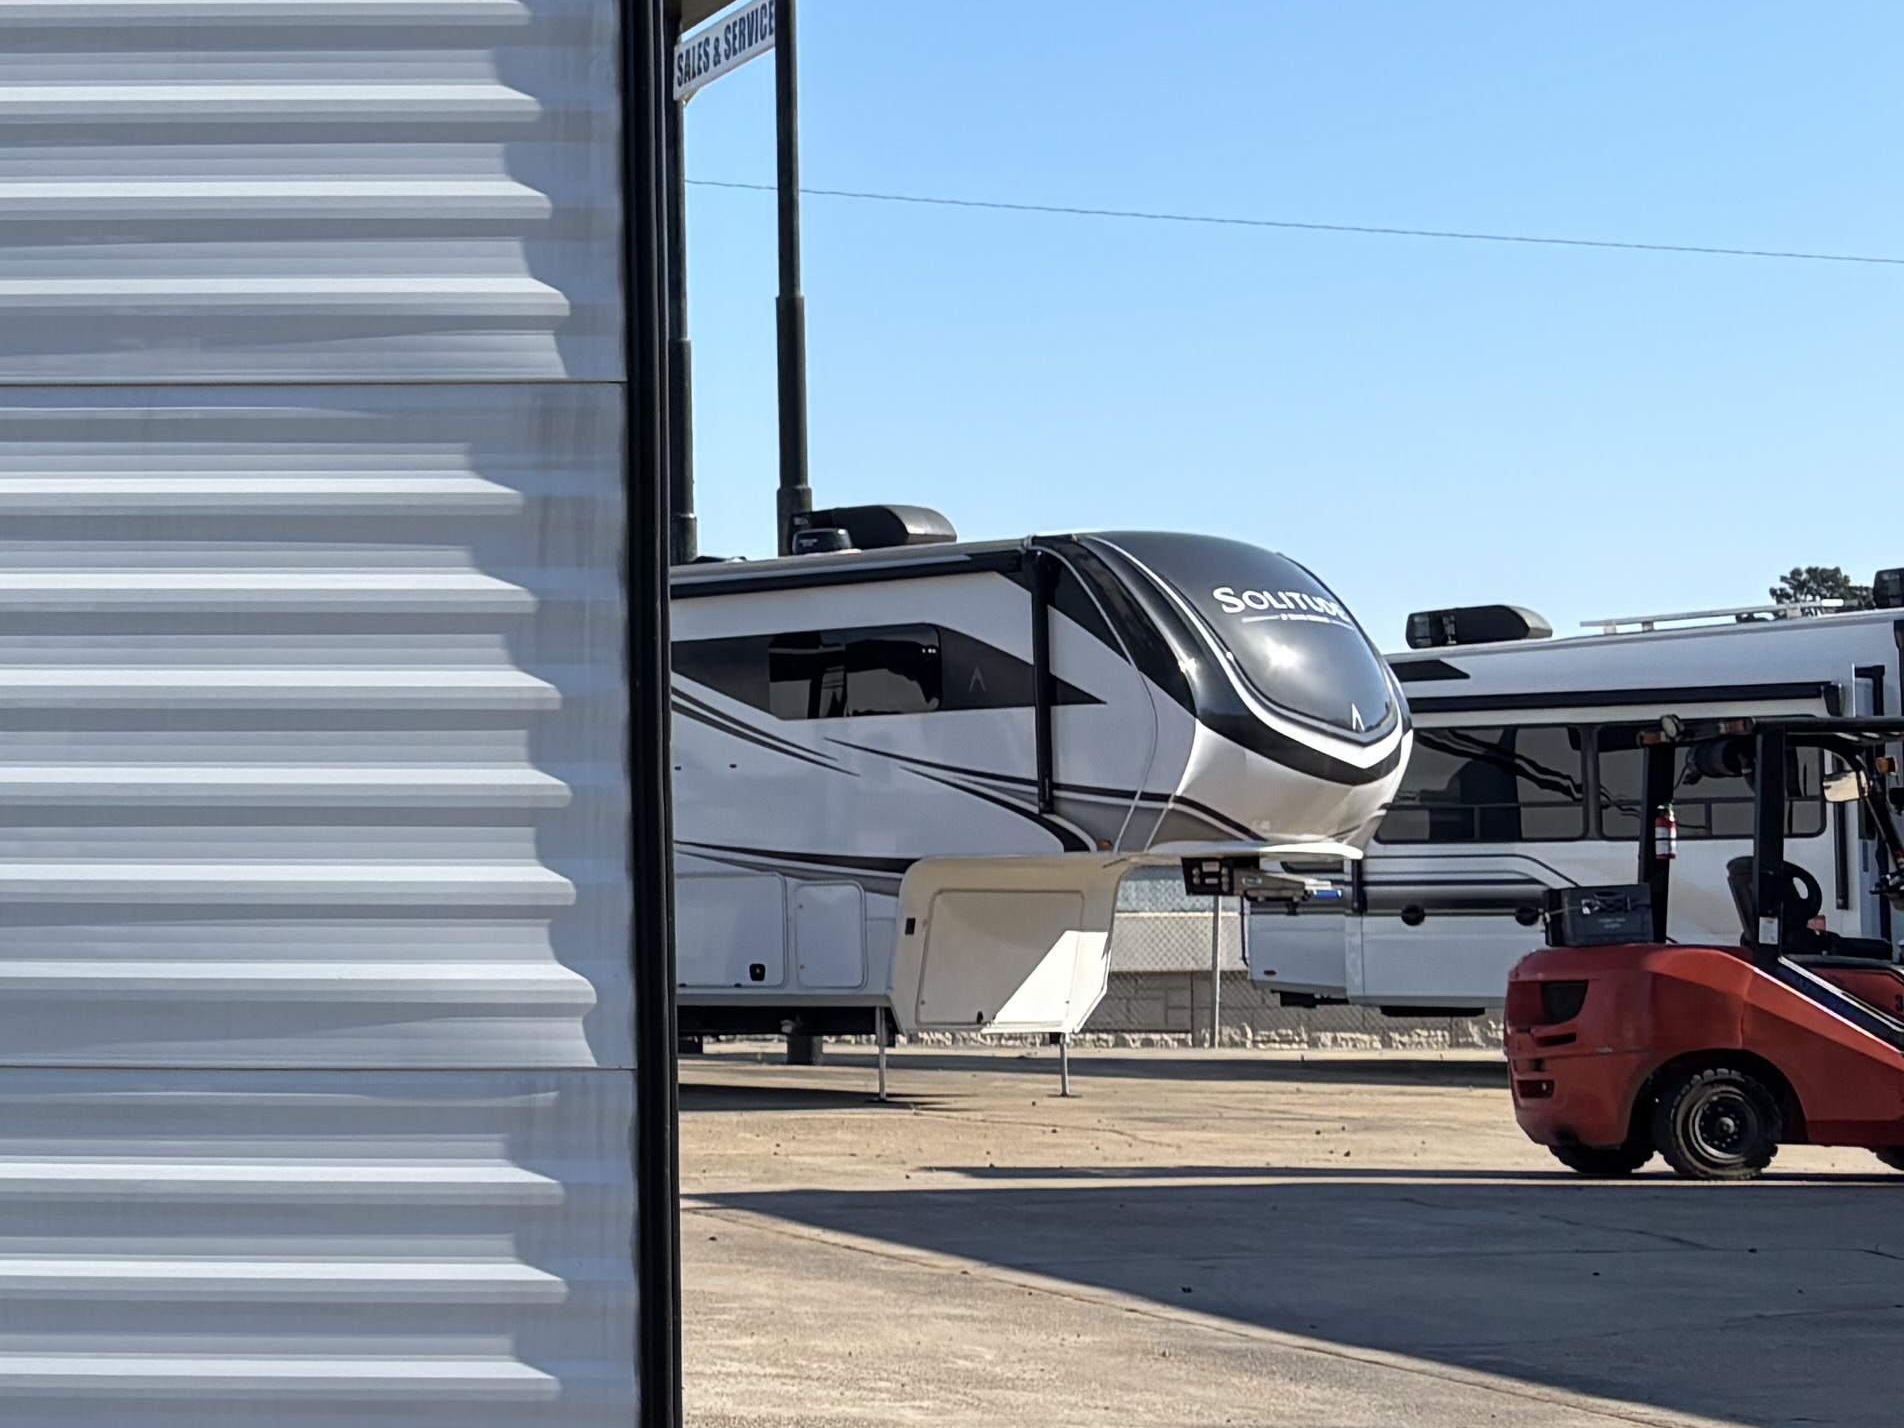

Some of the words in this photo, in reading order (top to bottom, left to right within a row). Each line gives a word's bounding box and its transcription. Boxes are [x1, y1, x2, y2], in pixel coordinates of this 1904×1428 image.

[677, 36, 710, 87] SALES
[713, 36, 721, 68] &
[724, 0, 774, 61] SERVICE
